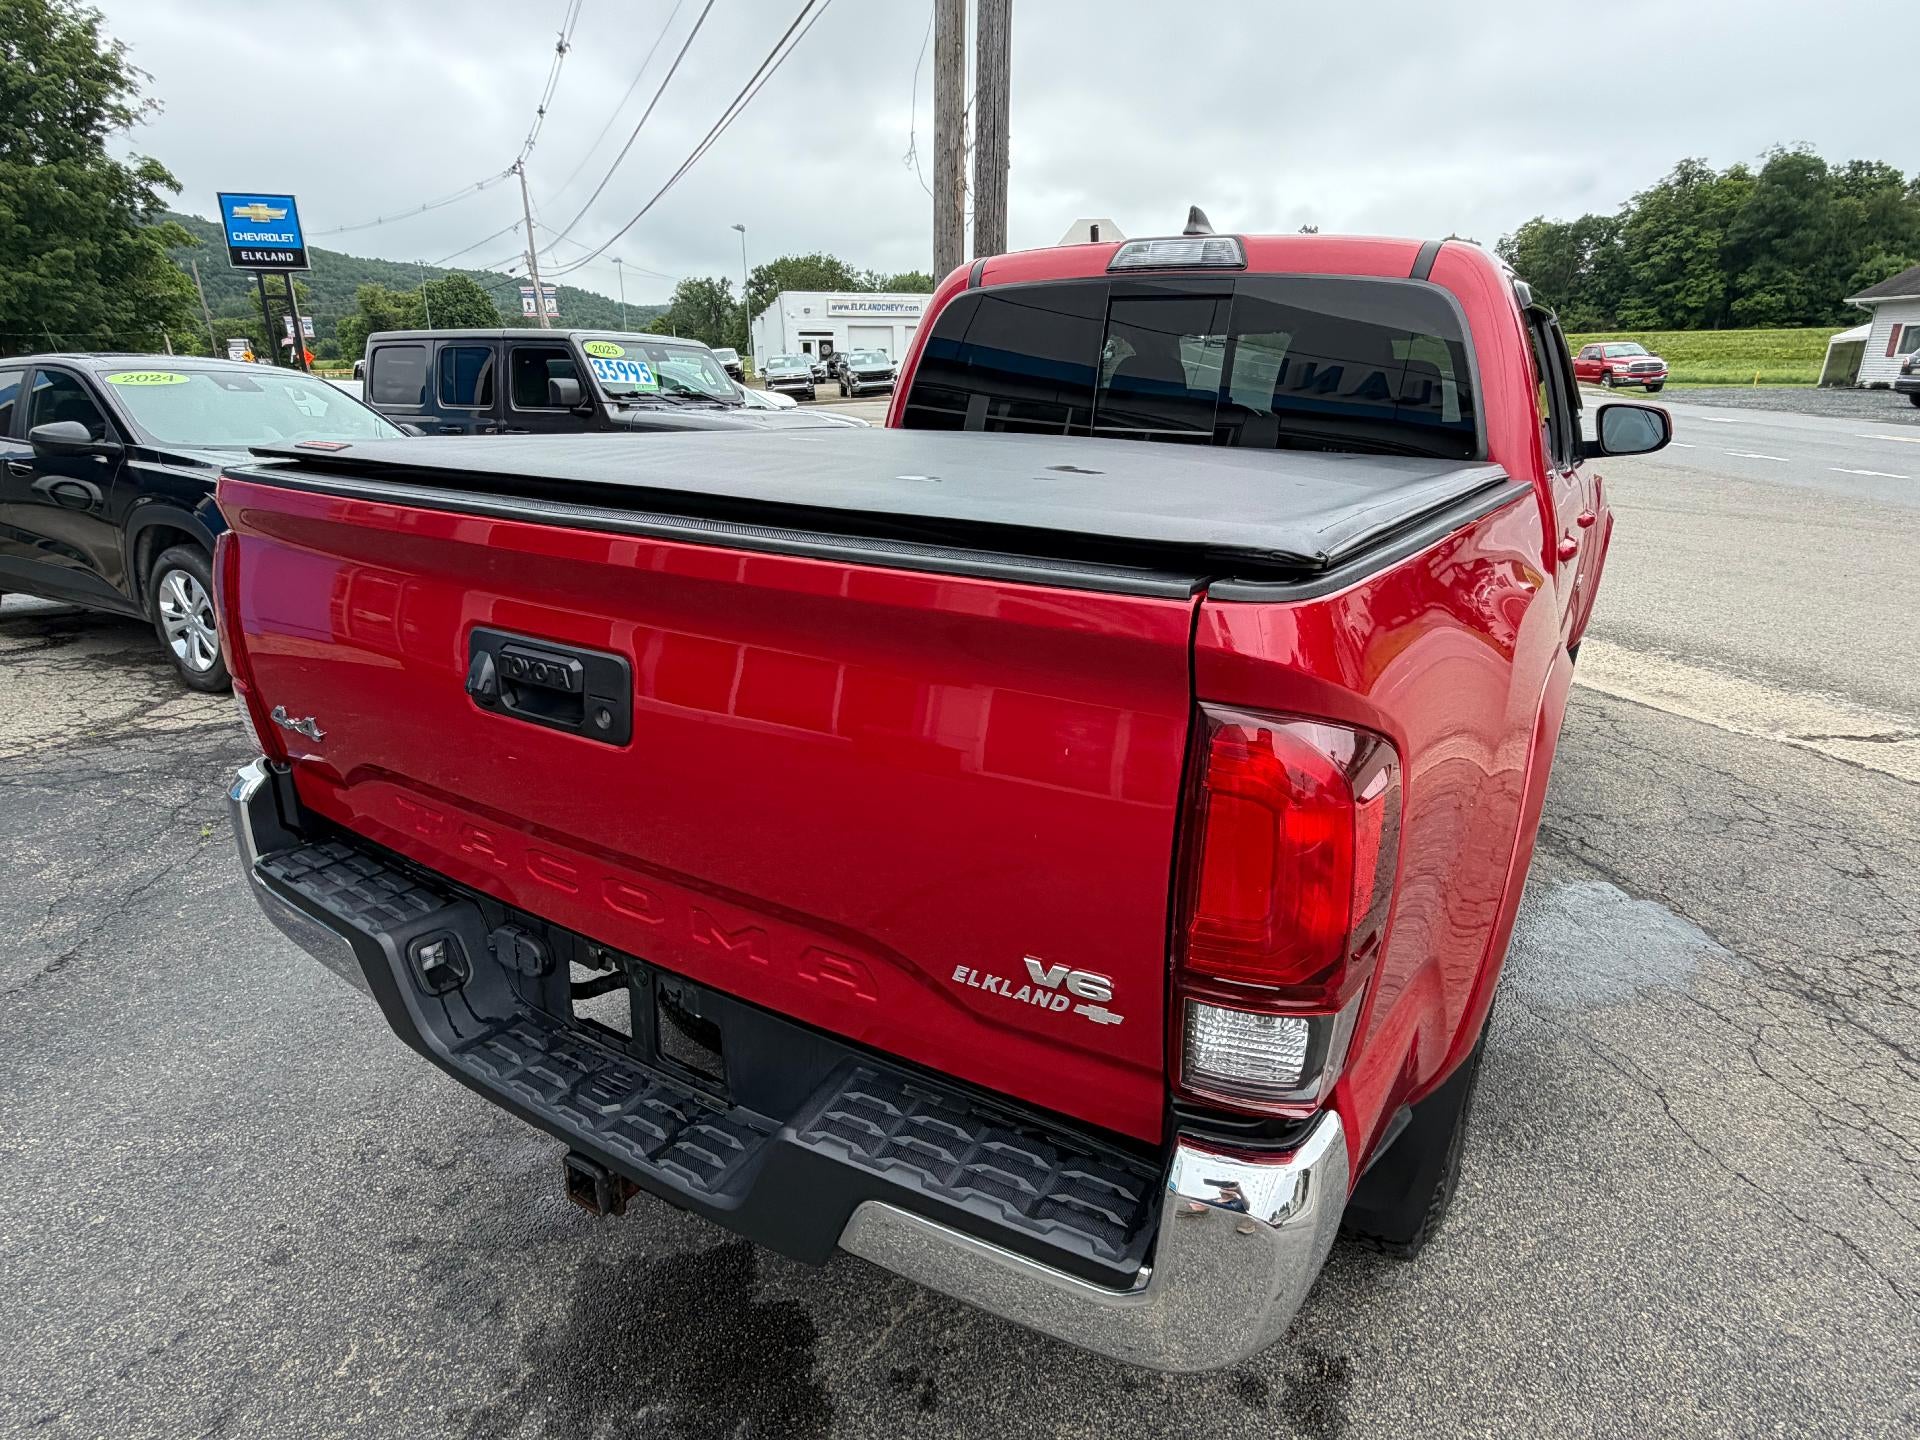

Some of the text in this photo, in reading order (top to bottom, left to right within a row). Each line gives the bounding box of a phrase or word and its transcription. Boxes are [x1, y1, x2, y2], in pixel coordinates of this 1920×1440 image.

[232, 231, 295, 242] CHEVROLET
[241, 251, 294, 262] ELKLAND
[831, 302, 920, 312] www.ELKLANDCHEVY.com
[592, 344, 618, 355] 2025
[122, 374, 174, 383] 2024
[592, 360, 653, 383] 35995
[500, 653, 572, 690] TOYOTA
[395, 795, 878, 1002] TACOMA
[1023, 954, 1114, 1002] V6
[951, 964, 1071, 1012] ELKLAND
